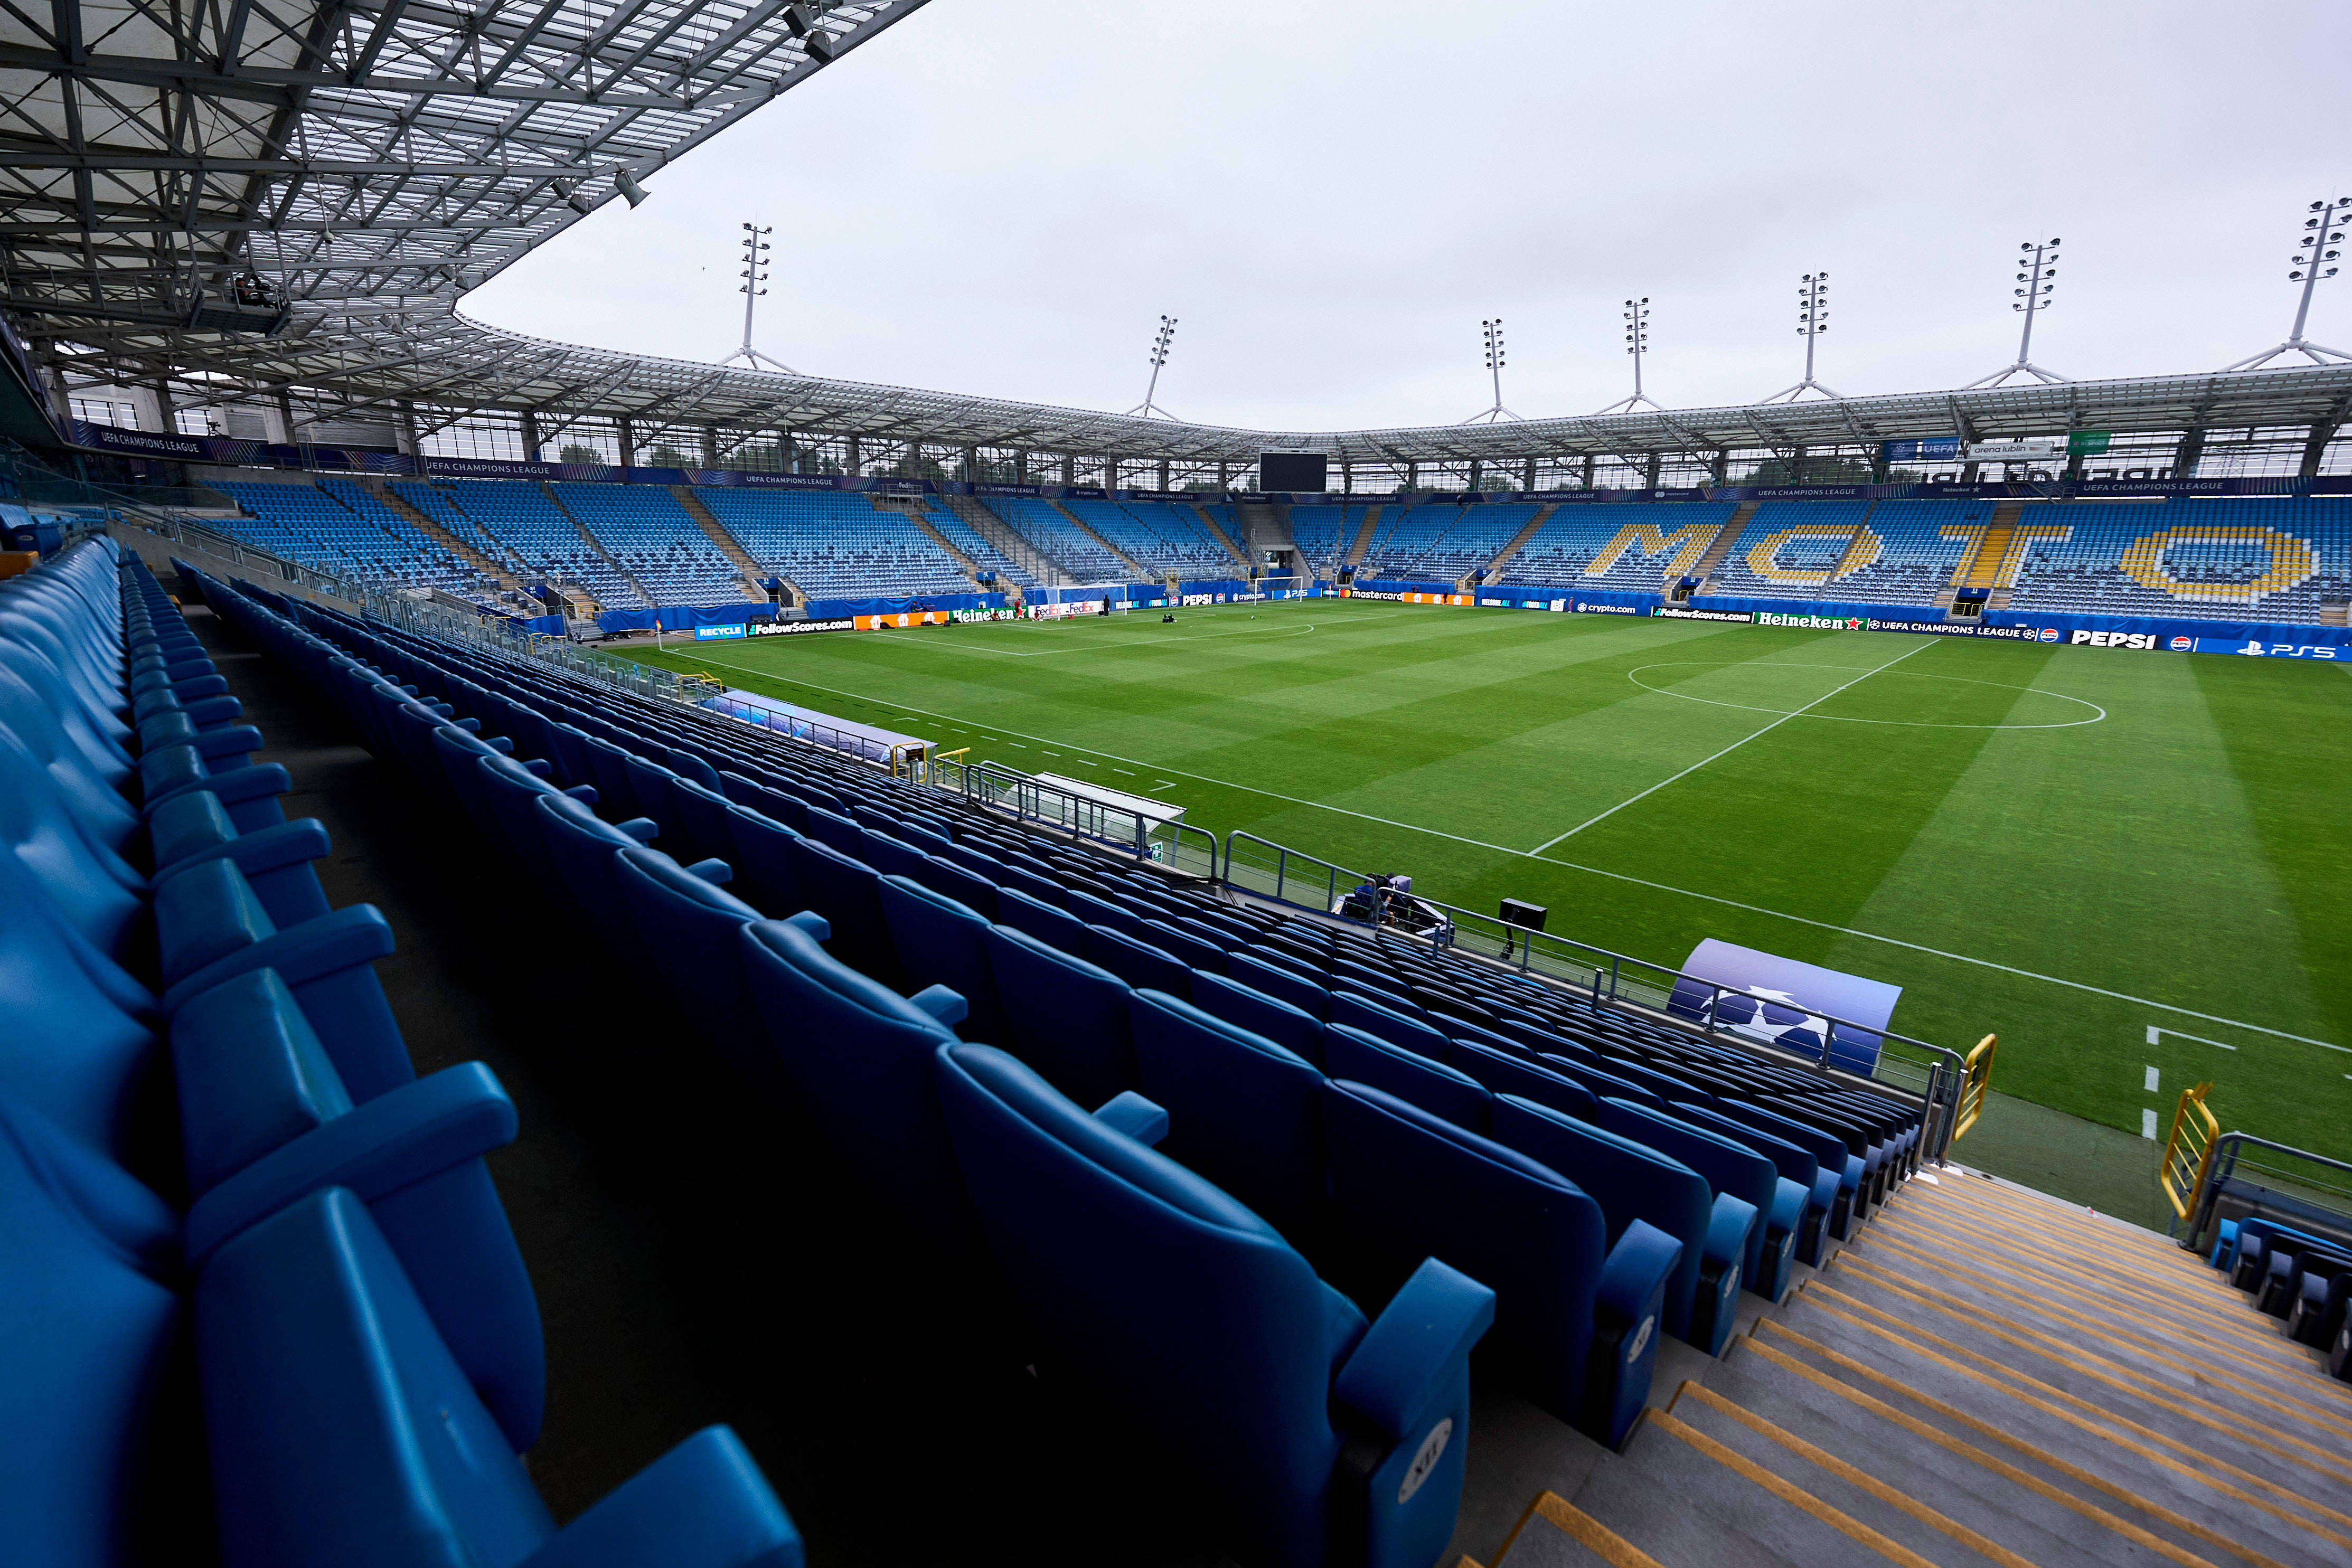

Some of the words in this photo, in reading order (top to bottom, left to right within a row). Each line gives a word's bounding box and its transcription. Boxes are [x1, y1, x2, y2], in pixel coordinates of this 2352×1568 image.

[101, 431, 119, 443] UEFA
[119, 434, 165, 449] CHAMPIONS
[165, 440, 200, 452] LEAGUE
[453, 462, 511, 473] CHAMPIONS
[513, 466, 550, 475] LEAGUE
[766, 476, 806, 485] CHAMPIONS
[1182, 593, 1212, 606] PEPSI
[1352, 591, 1403, 601] mastercard
[1036, 604, 1062, 616] FedEx
[1069, 602, 1094, 613] FedEx
[1588, 604, 1636, 614] crypto.com
[1659, 608, 1750, 622] FollowScores.com
[1758, 612, 1843, 630] Heineken
[699, 627, 741, 636] RECYCLE
[755, 620, 852, 635] FollowScores.com
[1882, 621, 1909, 630] UEFA
[1911, 623, 1974, 634] CHAMPIONS
[1977, 627, 2020, 637] LEAGUE
[2071, 630, 2156, 650] PEPSI
[2270, 644, 2336, 658] PS5
